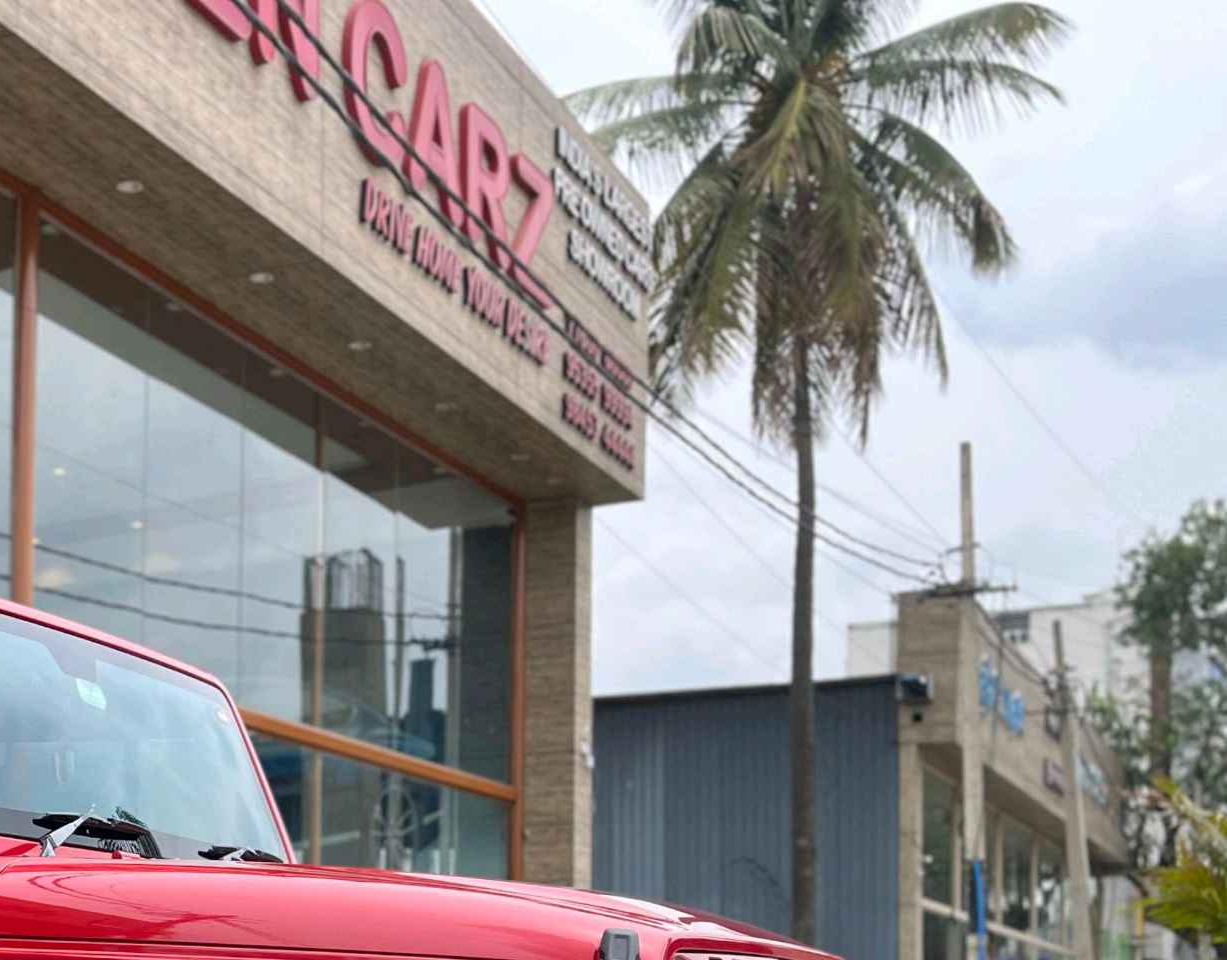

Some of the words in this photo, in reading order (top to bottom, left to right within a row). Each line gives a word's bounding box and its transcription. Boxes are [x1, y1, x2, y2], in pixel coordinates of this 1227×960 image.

[342, 0, 555, 312] CARZ
[359, 176, 413, 255] DRIVE
[412, 226, 462, 294] HOME
[463, 266, 505, 328] YOUR
